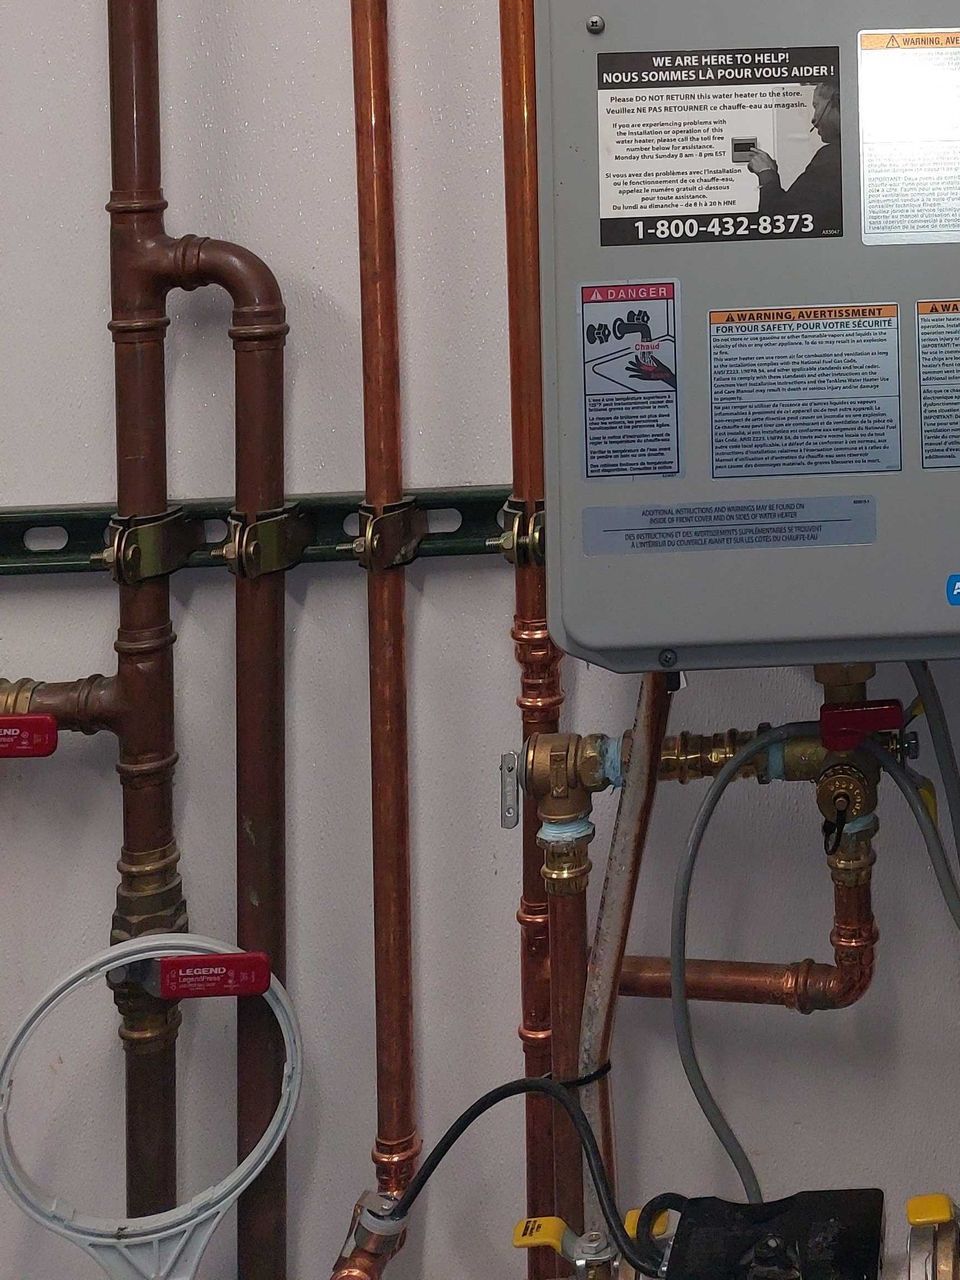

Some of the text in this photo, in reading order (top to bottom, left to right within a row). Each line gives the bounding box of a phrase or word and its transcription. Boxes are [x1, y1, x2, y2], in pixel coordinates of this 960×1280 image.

[903, 37, 944, 46] WARNING,
[652, 53, 789, 67] WE ARE HERE TO HELP!
[603, 72, 638, 83] NOUS
[642, 70, 696, 82] SOMMES
[699, 66, 715, 80] LÀ
[717, 68, 752, 79] POUR
[753, 67, 788, 78] VOUS
[791, 66, 828, 77] AIDER
[719, 102, 762, 110] chauffe-eau
[775, 101, 807, 109] magasin.
[672, 128, 701, 136] operation
[634, 214, 814, 240] 1-800-432-8373
[608, 288, 667, 299] DANGER
[736, 308, 882, 321] WARNING, AVERTISSMENT
[761, 323, 795, 332] SAFETY,
[796, 322, 821, 330] POUR
[823, 321, 850, 329] VOTRE
[852, 319, 892, 328] SÉCURITÉ
[634, 342, 660, 350] Chaud
[179, 967, 226, 975] LEGEND
